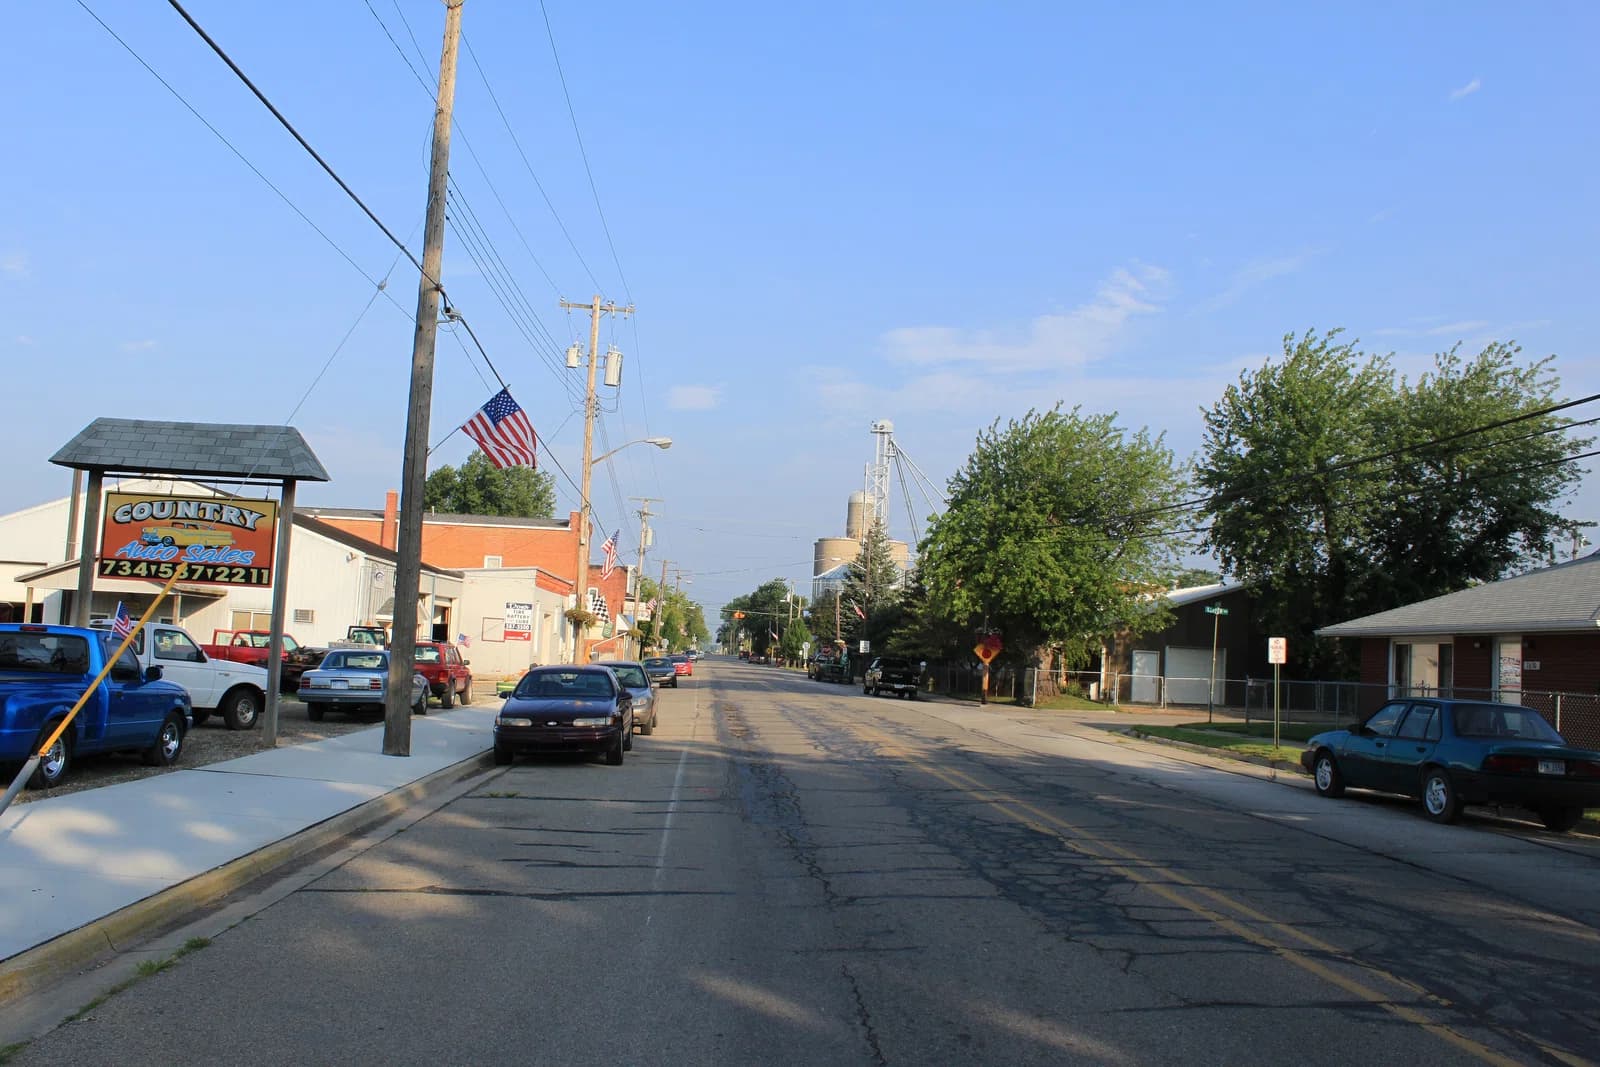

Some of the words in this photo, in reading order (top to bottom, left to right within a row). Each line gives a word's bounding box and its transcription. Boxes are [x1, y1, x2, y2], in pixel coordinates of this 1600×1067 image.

[113, 500, 267, 531] COUNTRY
[115, 540, 180, 562] Auto
[181, 543, 256, 565] Sales
